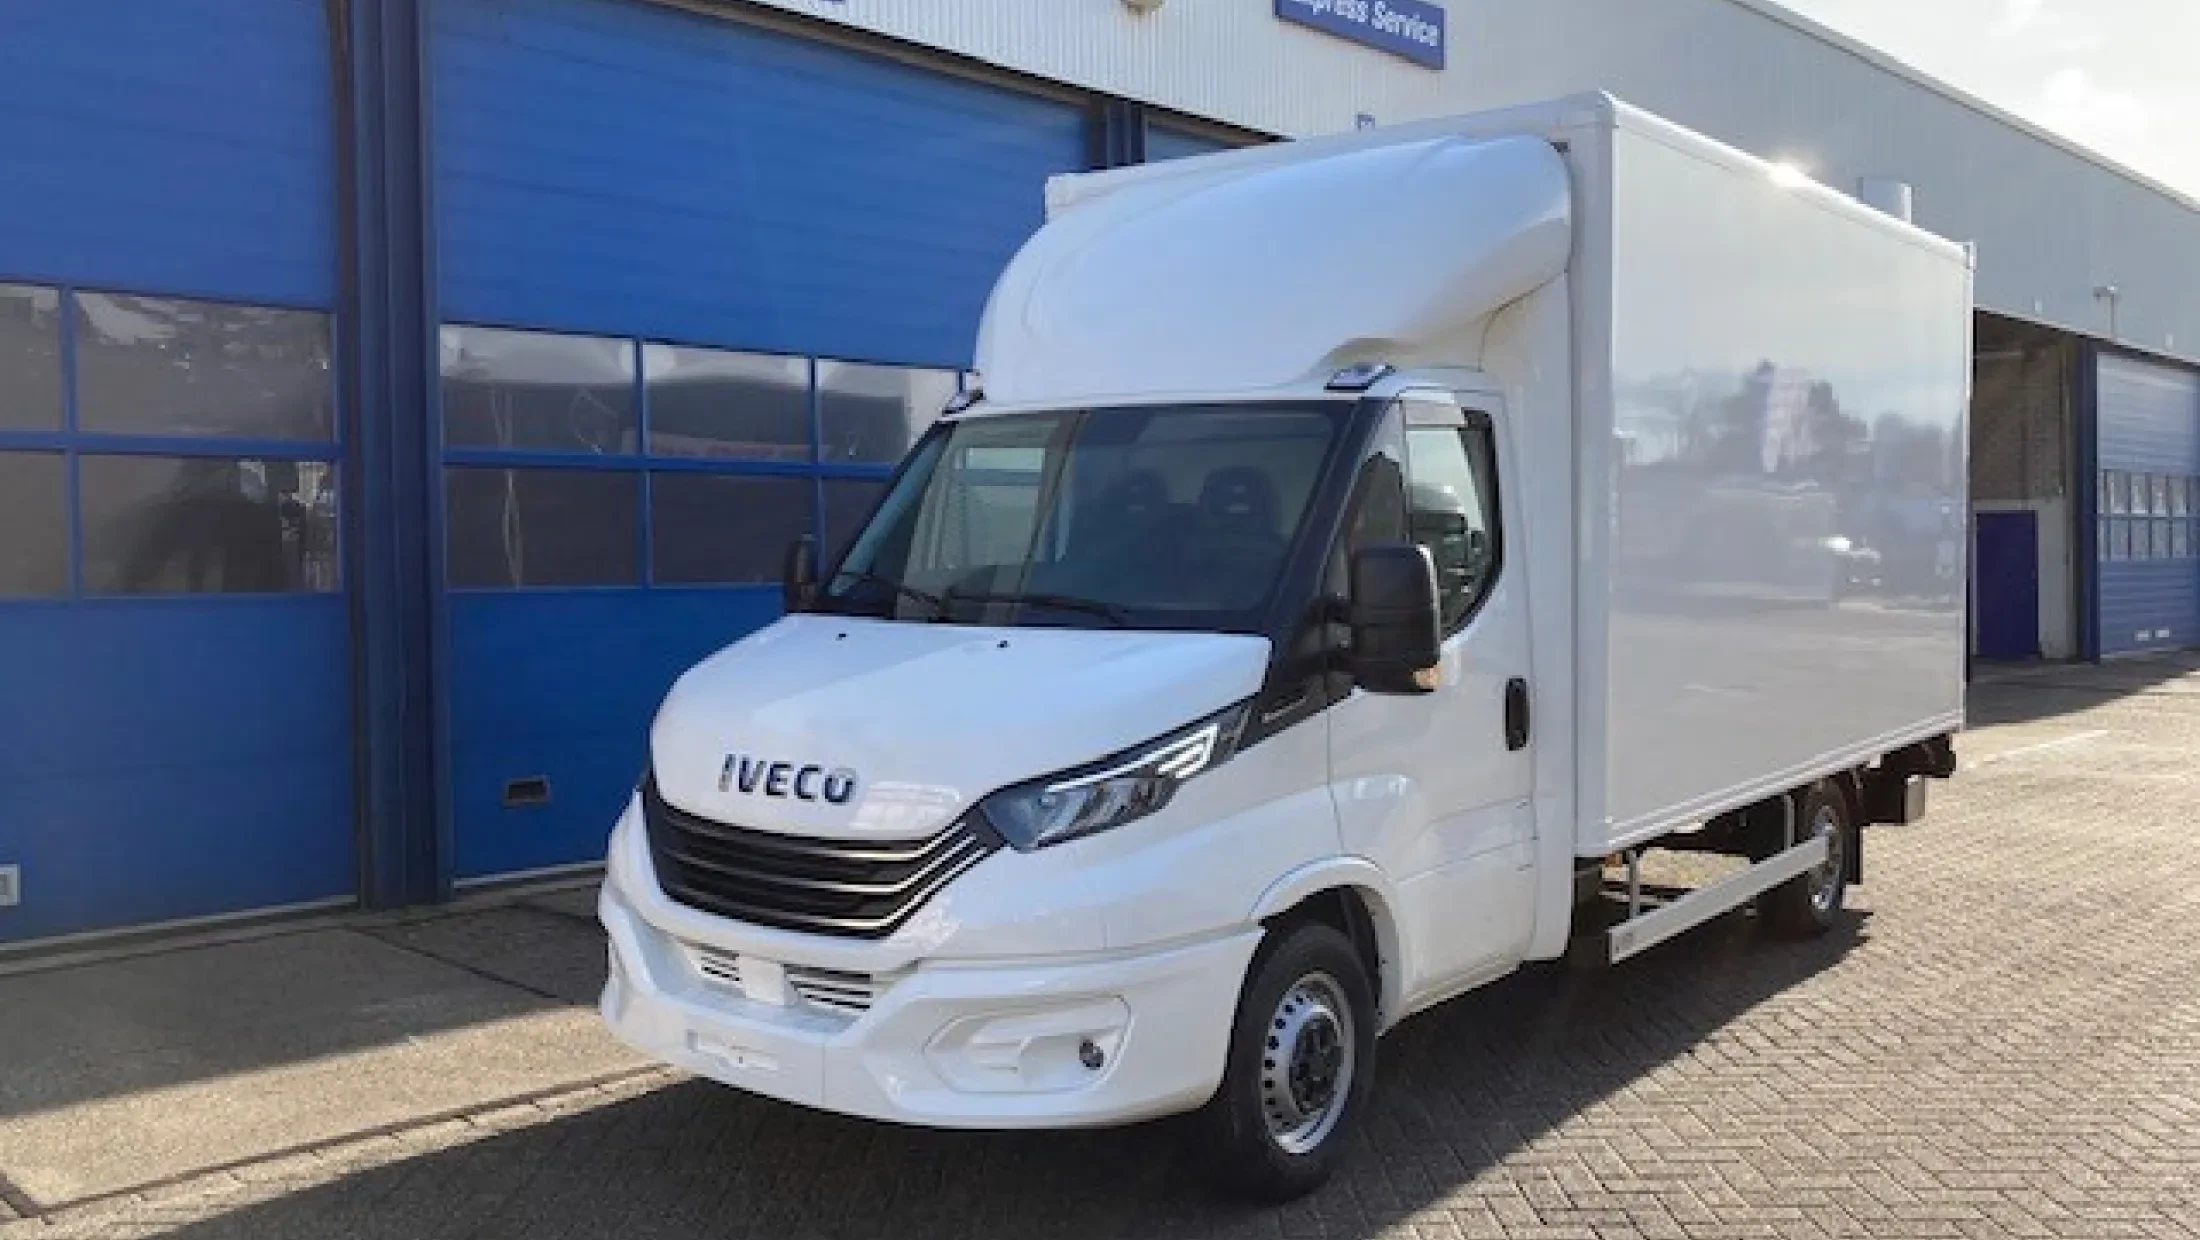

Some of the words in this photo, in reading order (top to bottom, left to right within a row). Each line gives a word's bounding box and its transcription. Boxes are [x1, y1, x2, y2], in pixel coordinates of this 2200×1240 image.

[1293, 0, 1369, 22] press
[1371, 0, 1438, 47] Service
[718, 753, 857, 805] IVECO
